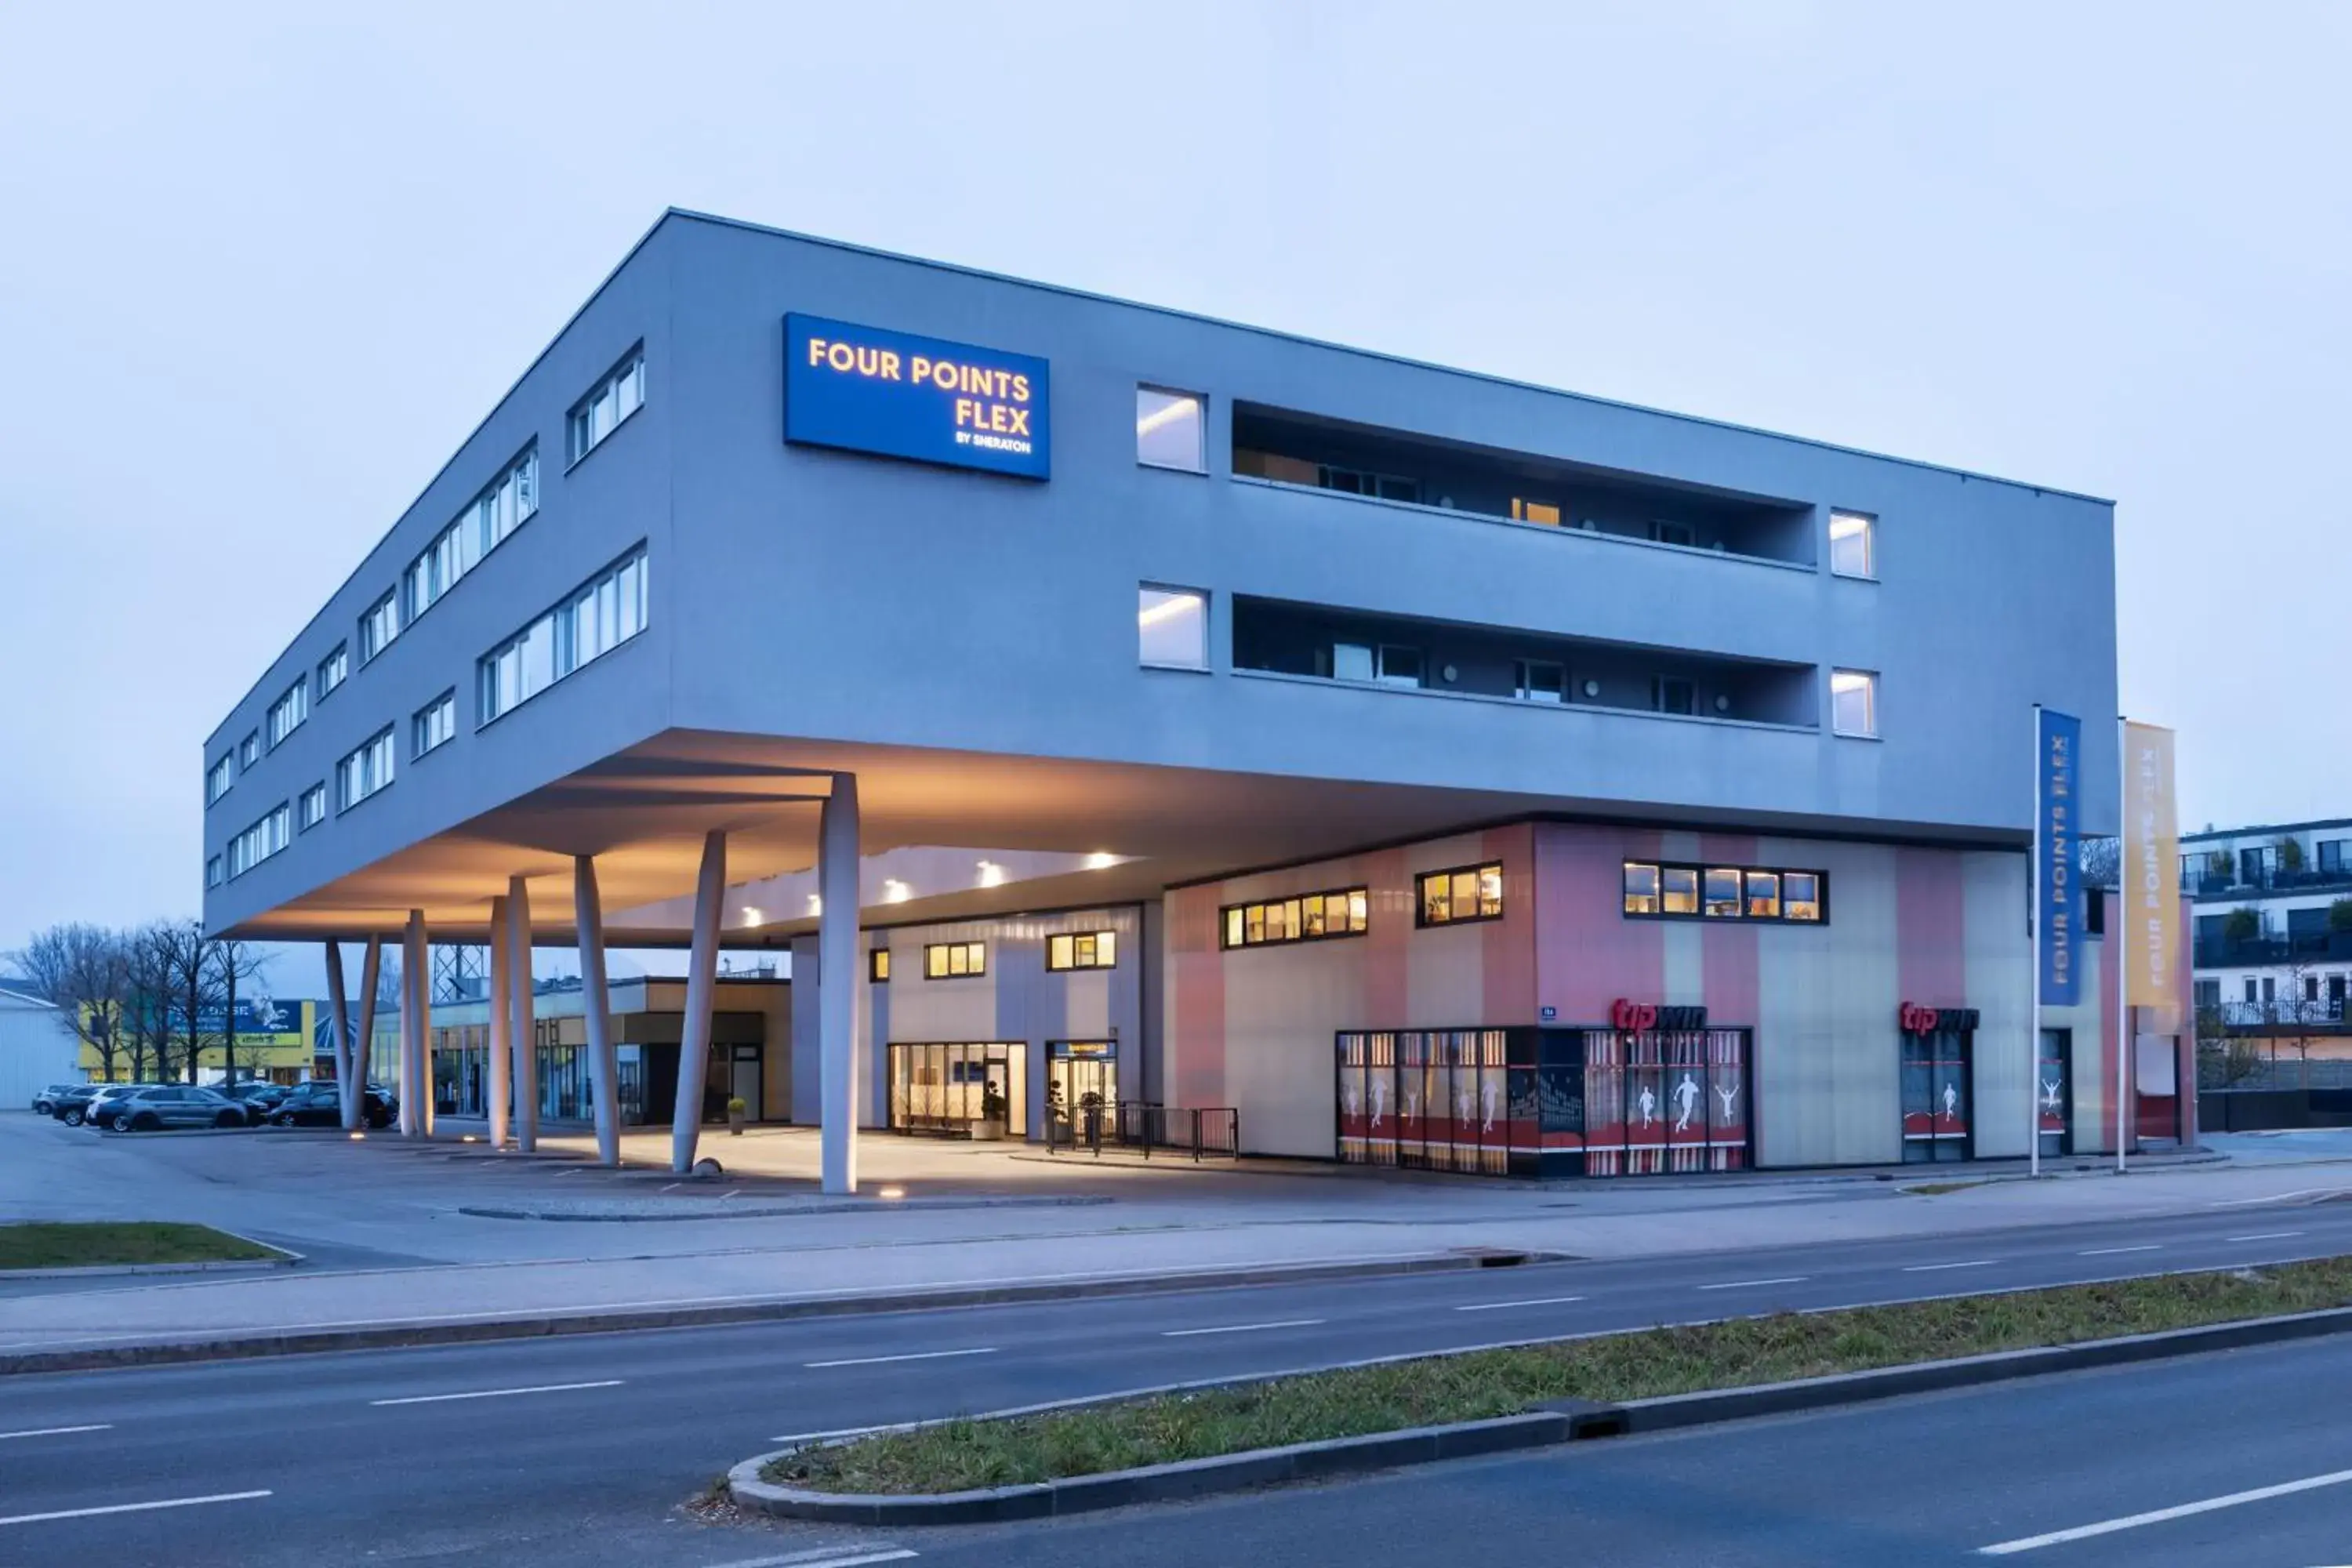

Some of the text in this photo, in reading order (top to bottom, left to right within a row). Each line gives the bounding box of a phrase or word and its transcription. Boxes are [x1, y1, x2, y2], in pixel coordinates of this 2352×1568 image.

[809, 339, 1030, 402] FOUR POINTS
[956, 398, 1029, 437] FLEX
[956, 430, 1032, 454] BY SHERATON
[2052, 735, 2068, 796] FLEX
[2052, 806, 2068, 903] POINTS
[2053, 913, 2069, 984] FOUR
[2147, 918, 2166, 987] FOUR
[1613, 998, 1708, 1036] tipwin
